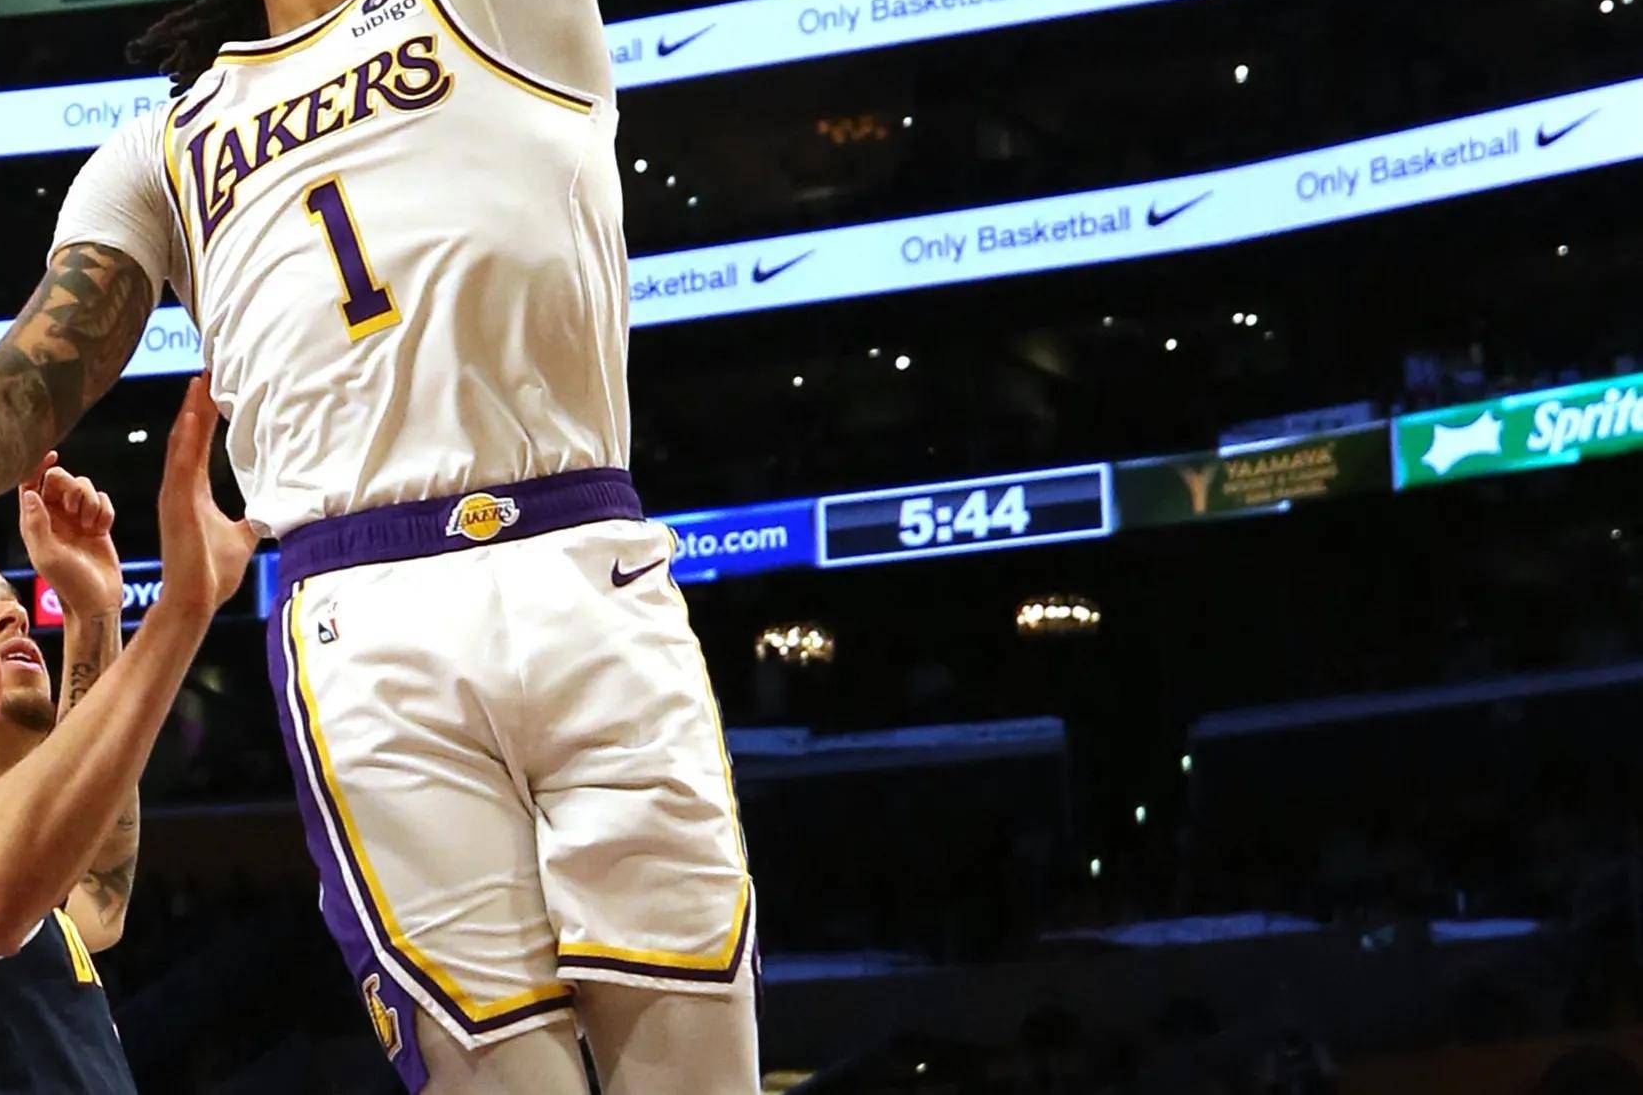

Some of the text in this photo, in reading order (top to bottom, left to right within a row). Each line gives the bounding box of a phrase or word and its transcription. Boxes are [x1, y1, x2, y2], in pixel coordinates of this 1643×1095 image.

[798, 6, 861, 36] Only
[63, 98, 123, 134] Only
[187, 35, 456, 253] LAKERS
[1296, 127, 1520, 202] Only Basketball
[303, 172, 402, 342] 1
[900, 205, 1132, 265] Only Basketball
[629, 263, 739, 301] sketball
[673, 525, 788, 563] to.com
[898, 484, 1031, 549] 5:44
